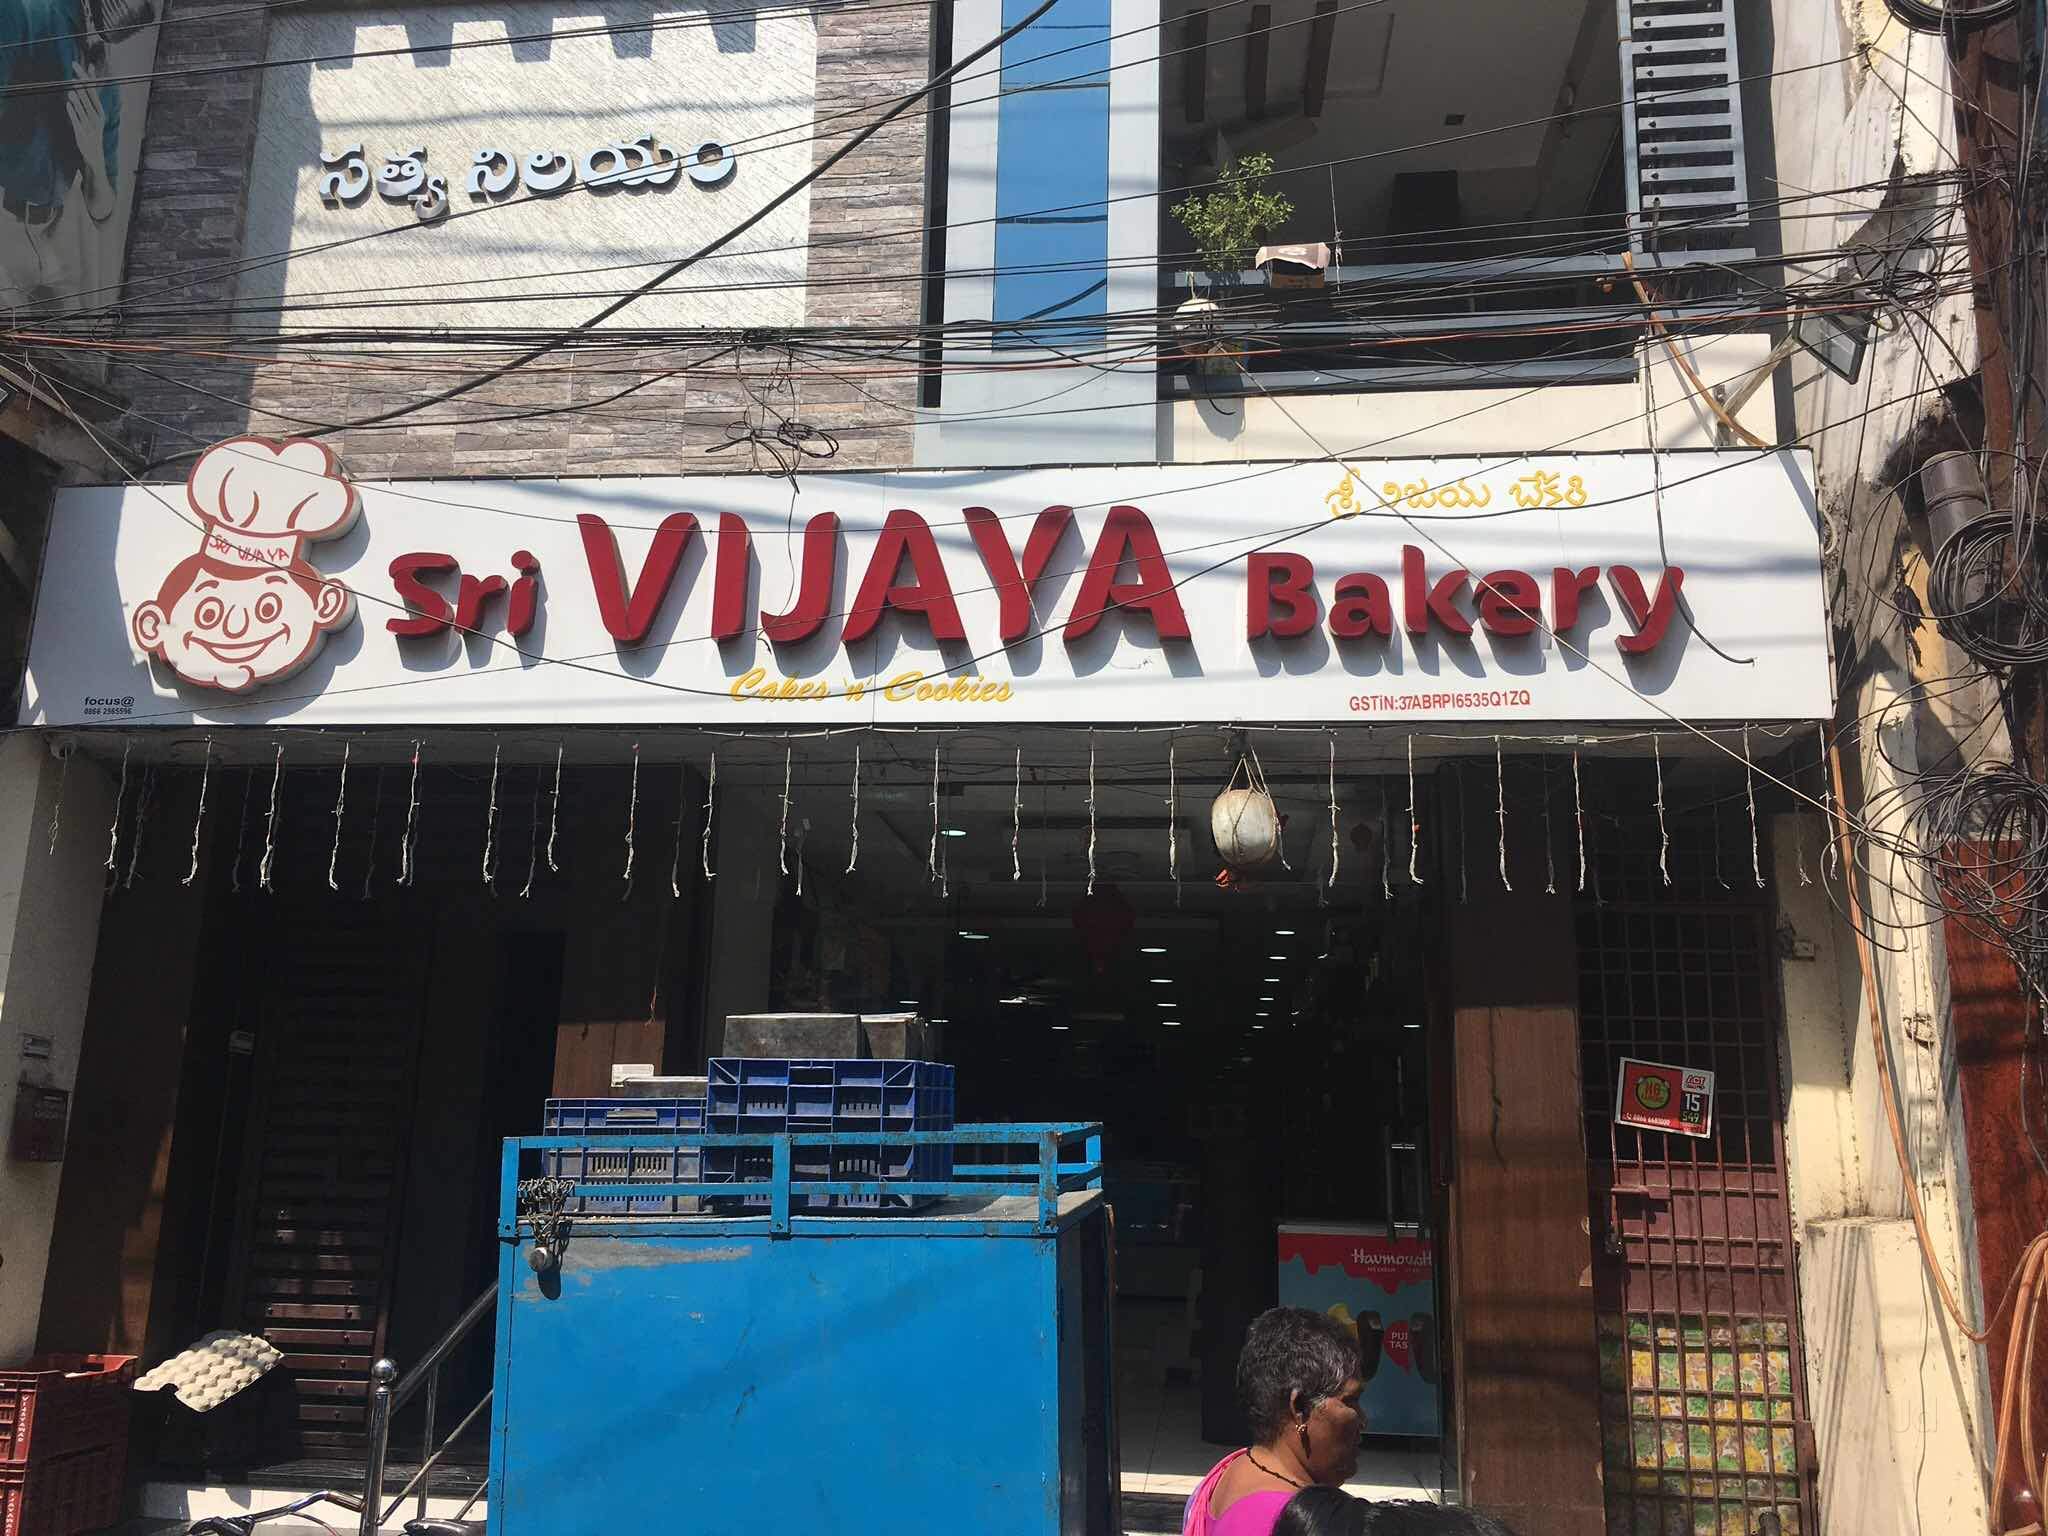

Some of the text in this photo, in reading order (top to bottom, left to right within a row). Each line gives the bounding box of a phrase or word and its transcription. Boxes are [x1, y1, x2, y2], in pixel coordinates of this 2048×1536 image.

[318, 133, 738, 227] సత్య నిలయం
[1325, 468, 1361, 519] శ్రీ
[385, 505, 1685, 652] Sri VIJAYA Bakery
[730, 667, 832, 702] Cakes
[883, 671, 1015, 702] Cookies
[1685, 1093, 1701, 1113] 15
